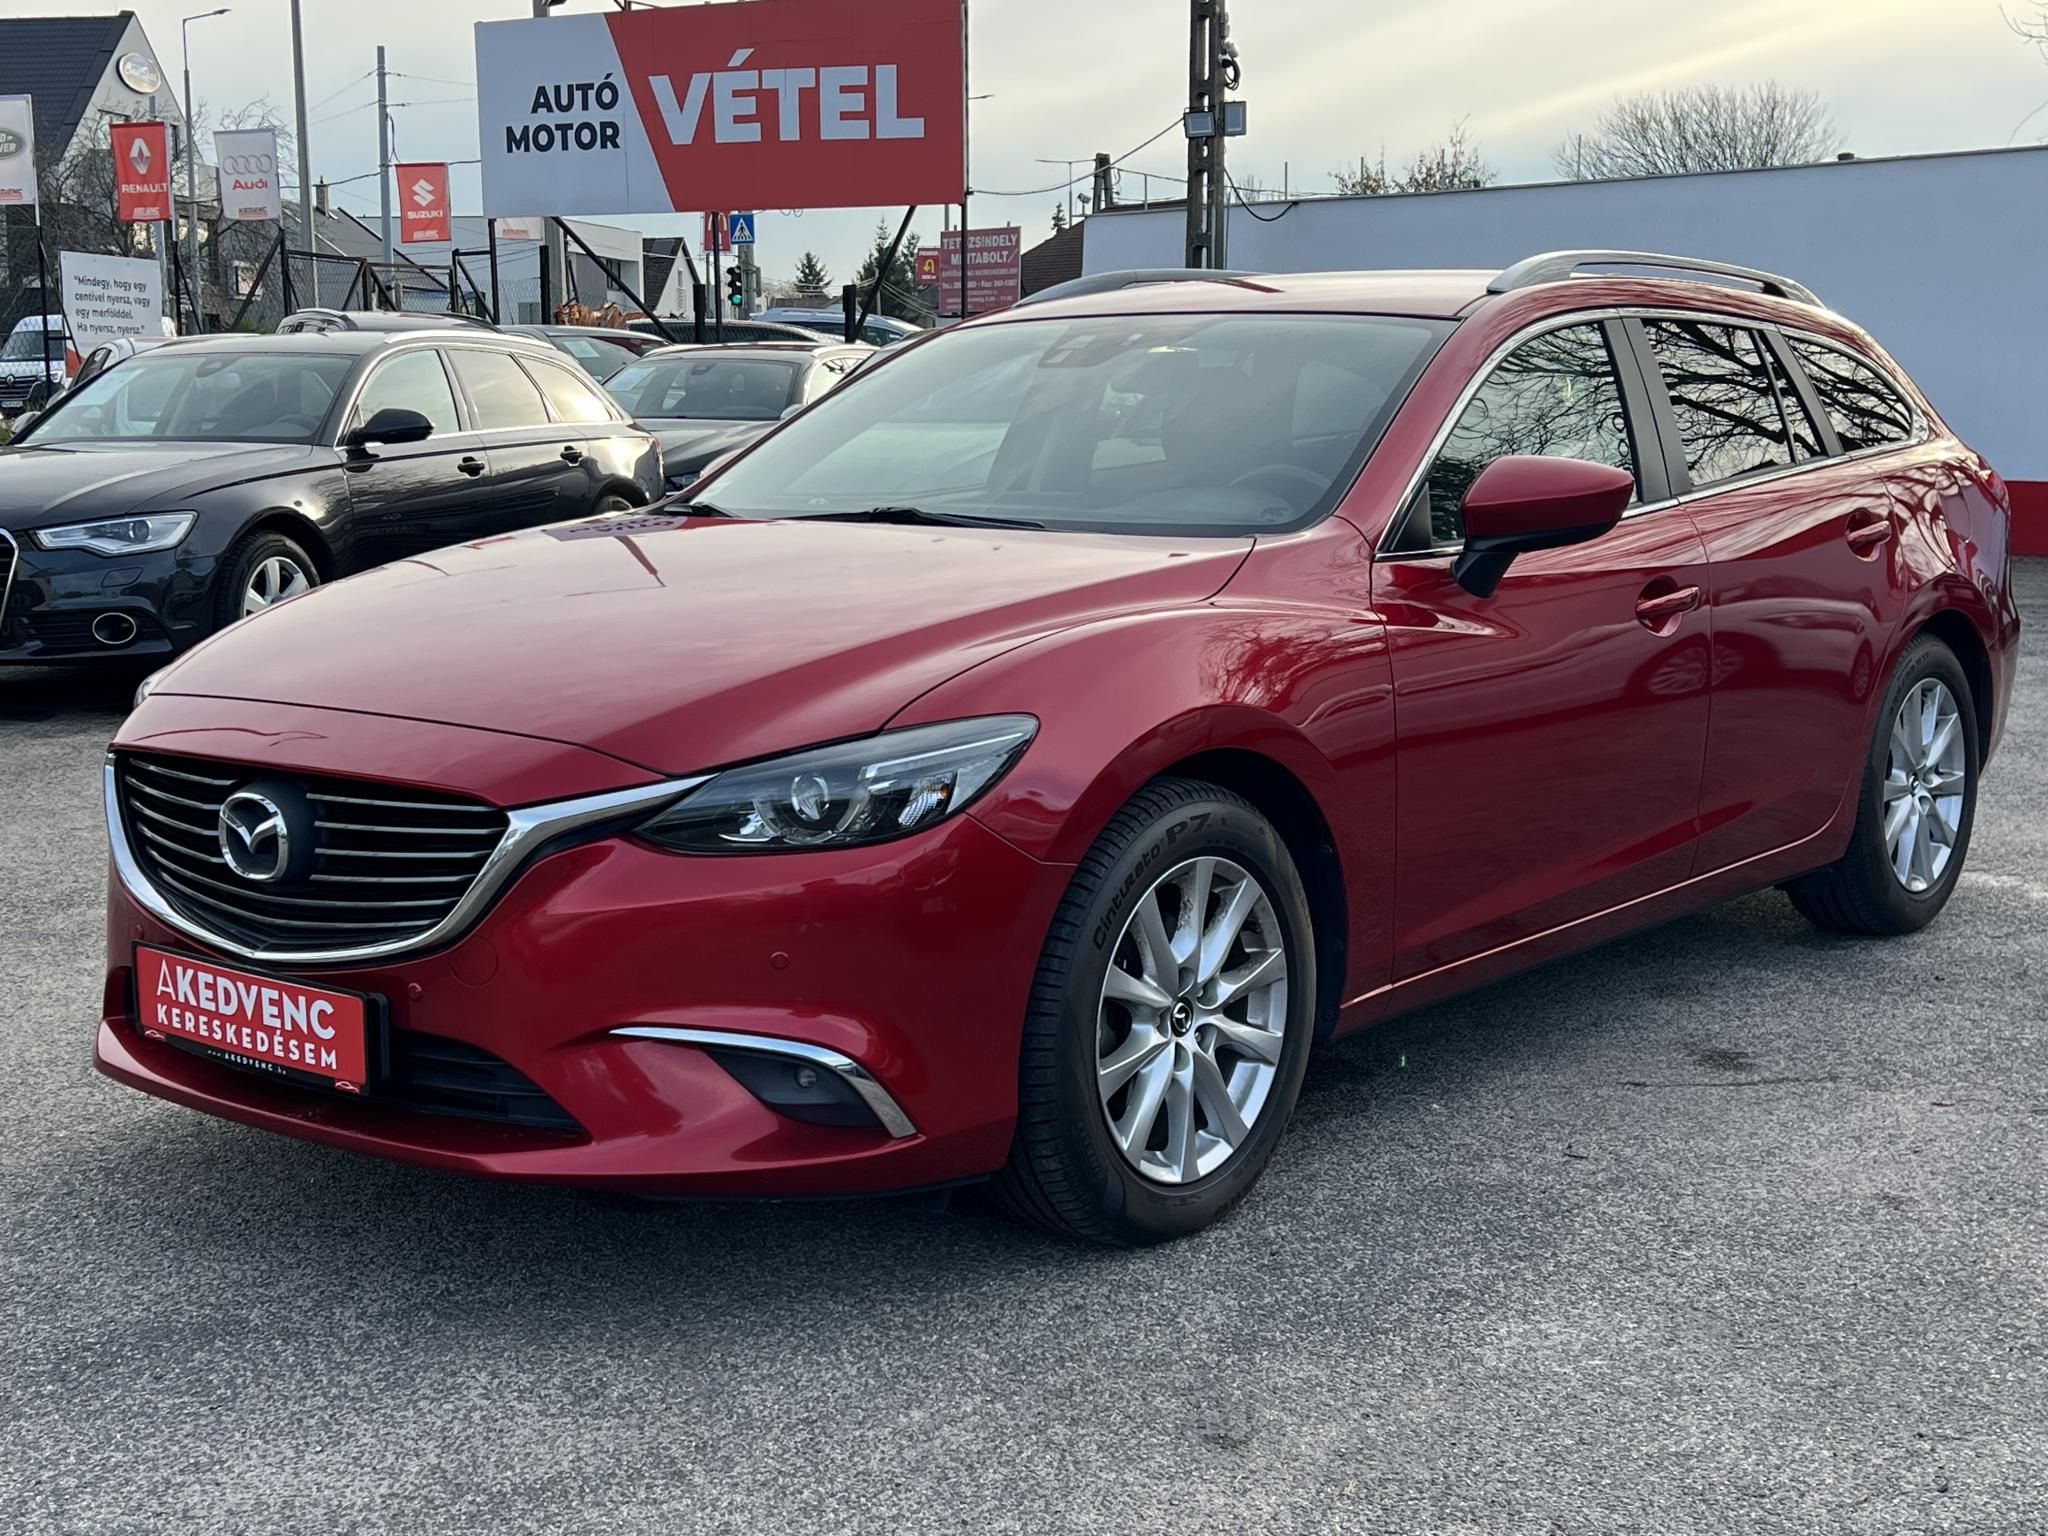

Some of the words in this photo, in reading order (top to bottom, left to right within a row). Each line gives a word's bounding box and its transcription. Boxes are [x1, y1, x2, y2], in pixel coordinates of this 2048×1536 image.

[530, 72, 619, 115] AUTÓ
[648, 48, 926, 145] VÉTEL
[505, 121, 620, 154] MOTOR
[121, 182, 168, 194] RENAULT
[232, 177, 268, 190] Audi
[407, 210, 443, 220] SUZUKI
[942, 234, 1018, 250] TETZSINDELY
[77, 322, 87, 331] Ha
[156, 1003, 337, 1070] KERESKEDÉSEM
